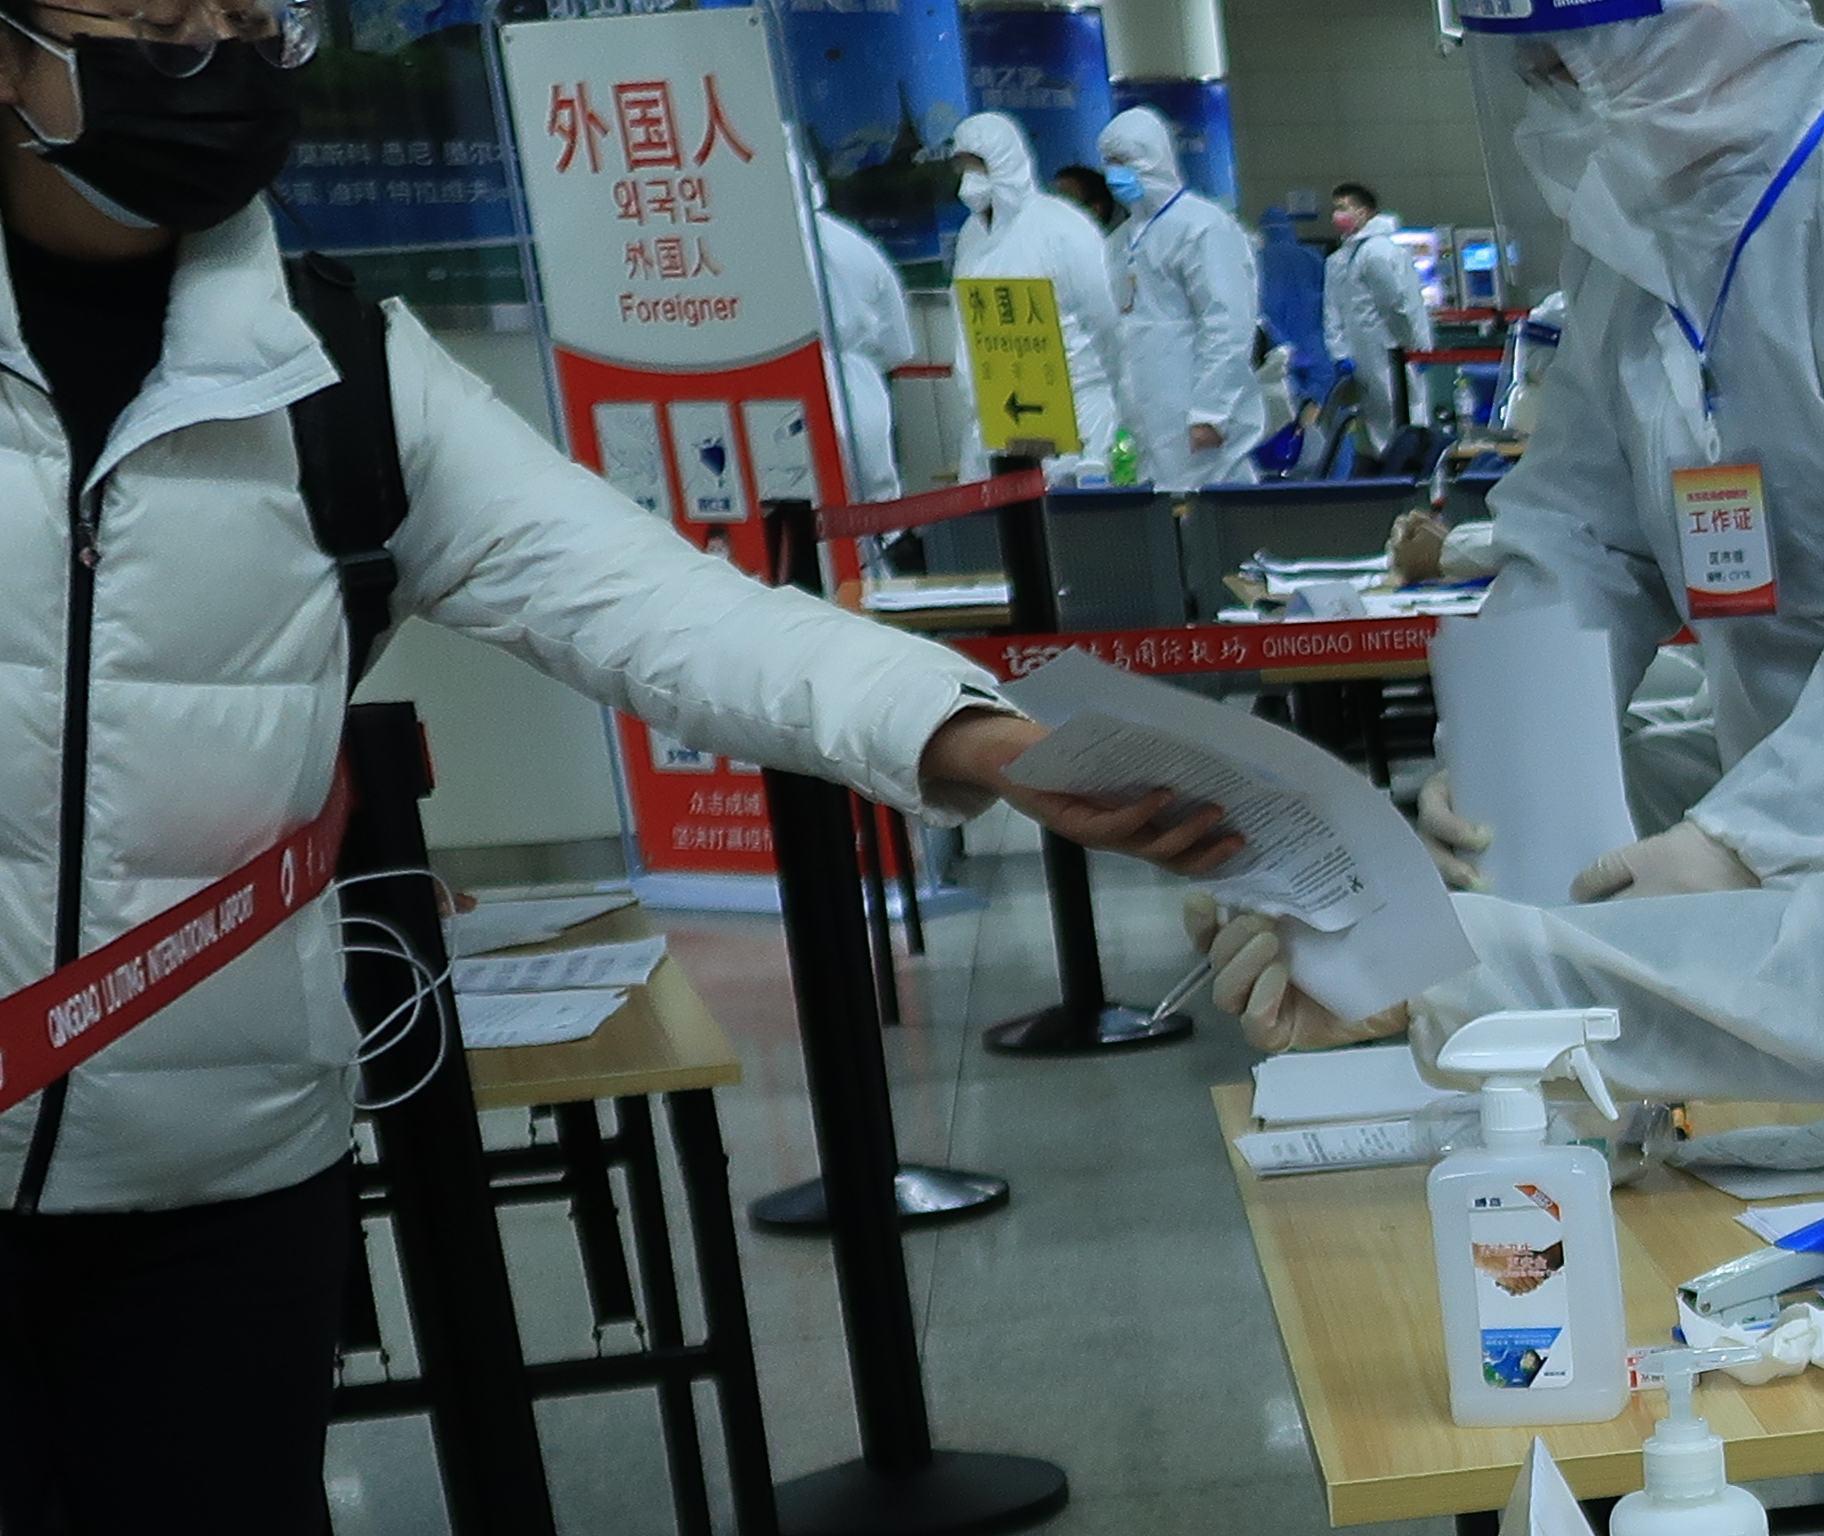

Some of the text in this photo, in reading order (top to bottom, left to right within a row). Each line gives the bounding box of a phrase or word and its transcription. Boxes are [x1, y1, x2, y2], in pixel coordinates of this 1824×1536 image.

[548, 73, 756, 174] 外国人
[612, 177, 712, 225] 외국인
[624, 237, 722, 280] 外国人
[618, 292, 740, 327] Foreigner
[969, 286, 1044, 324] 外国人
[974, 331, 1047, 358] Foreigner
[1689, 508, 1753, 533] 工作证
[1262, 632, 1354, 660] QINGDAO
[49, 983, 101, 1049] QINGDAO
